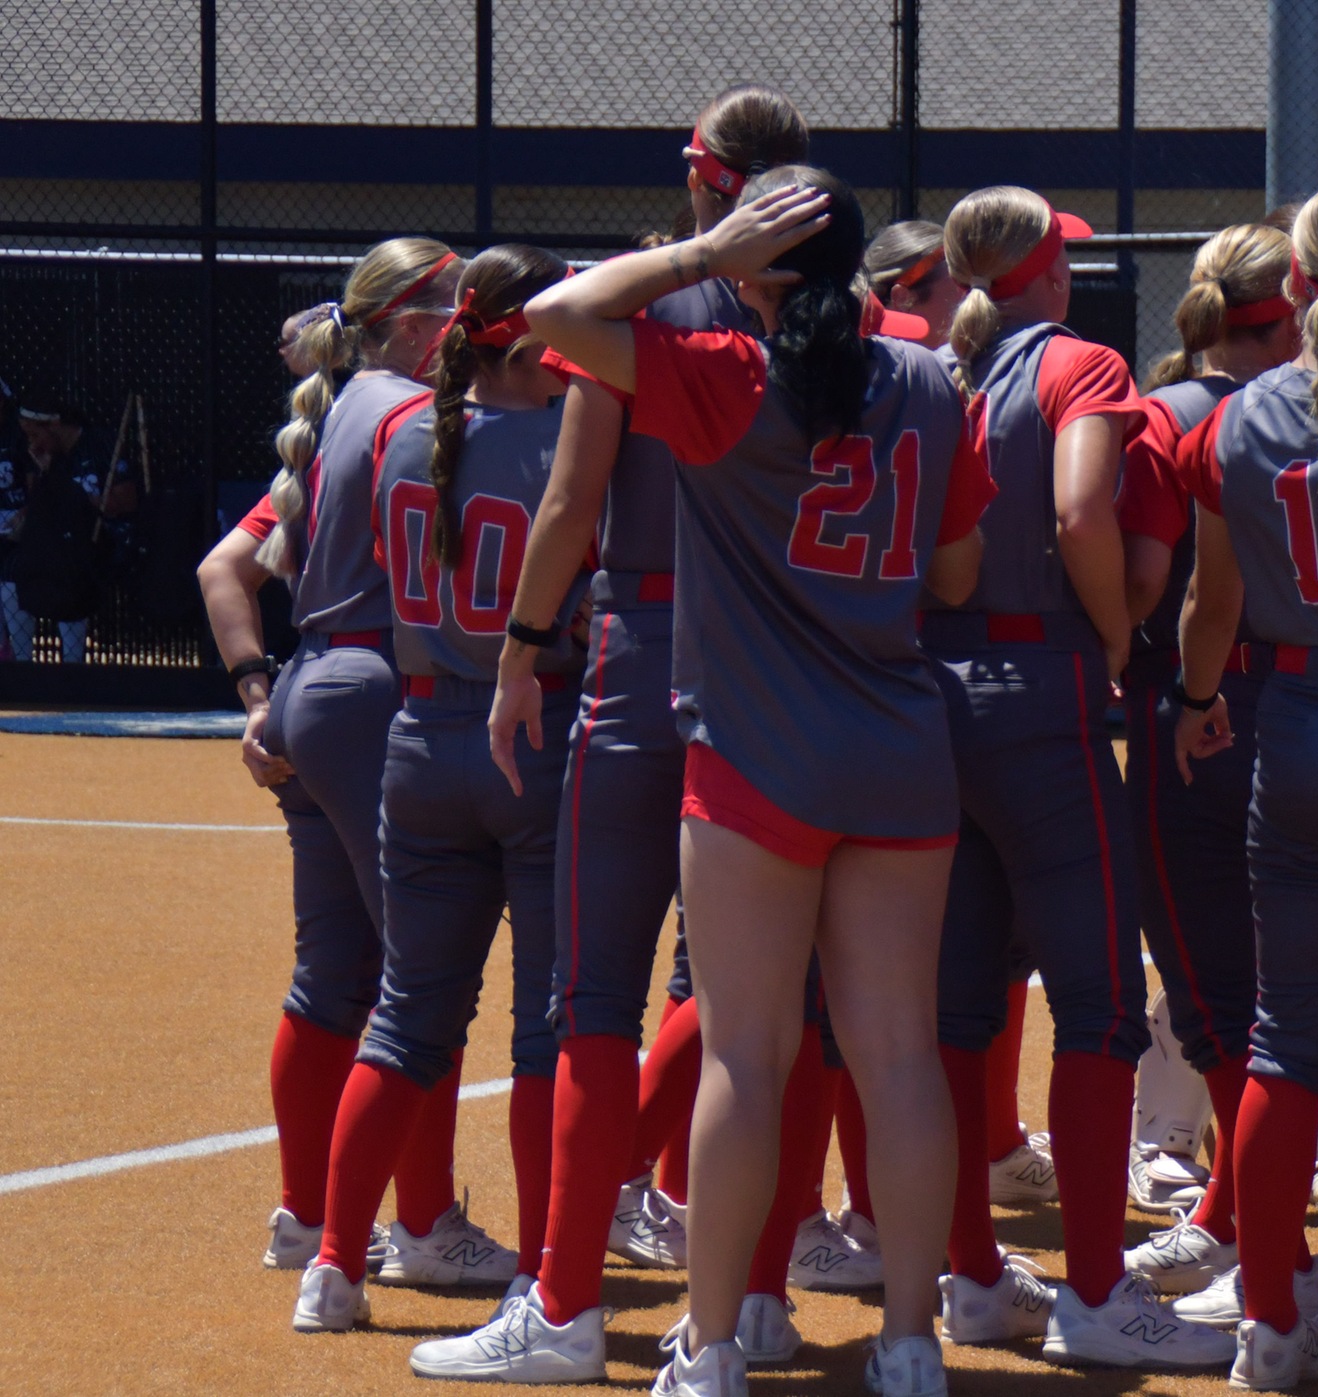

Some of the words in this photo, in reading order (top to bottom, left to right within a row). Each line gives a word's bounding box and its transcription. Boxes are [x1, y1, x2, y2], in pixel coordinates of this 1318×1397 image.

[787, 428, 921, 580] 21
[387, 478, 533, 635] 00
[442, 1239, 496, 1267] N
[797, 1245, 850, 1273] N
[1119, 1314, 1178, 1345] N
